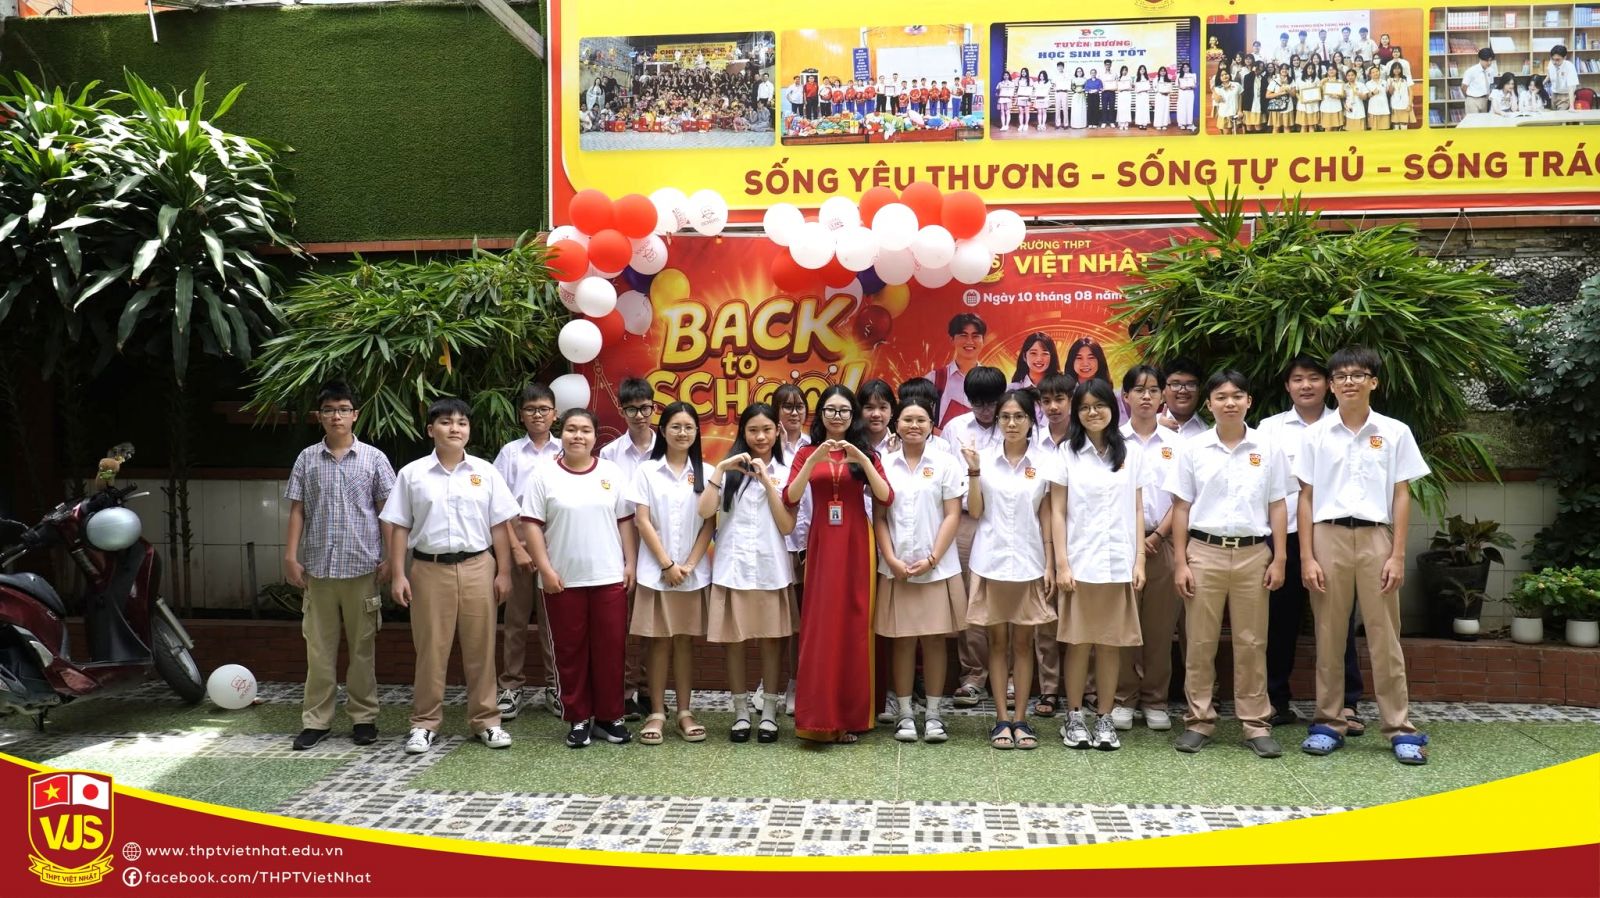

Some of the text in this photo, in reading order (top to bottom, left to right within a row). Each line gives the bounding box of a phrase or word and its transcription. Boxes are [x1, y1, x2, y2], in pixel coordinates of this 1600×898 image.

[1038, 51, 1065, 60] HỌC
[1069, 50, 1101, 58] SINH
[1118, 46, 1146, 57] TỐT
[744, 157, 839, 196] SỐNG
[848, 160, 915, 192] YÊU
[926, 162, 1080, 190] THƯƠNG
[1117, 148, 1217, 187] SỐNG
[1227, 158, 1278, 191] TỰ
[1289, 146, 1364, 183] CHỦ
[1404, 140, 1508, 181] SỐNG
[1518, 142, 1600, 177] TRÁ
[1017, 239, 1092, 250] RƯỜNG THPT
[1013, 250, 1073, 278] VIỆT
[983, 292, 1016, 305] Ngày
[1018, 291, 1033, 302] 10
[1035, 291, 1072, 304] tháng
[1074, 290, 1093, 301] 08
[1095, 289, 1123, 301] năm
[660, 295, 857, 368] BACK
[722, 350, 757, 376] to
